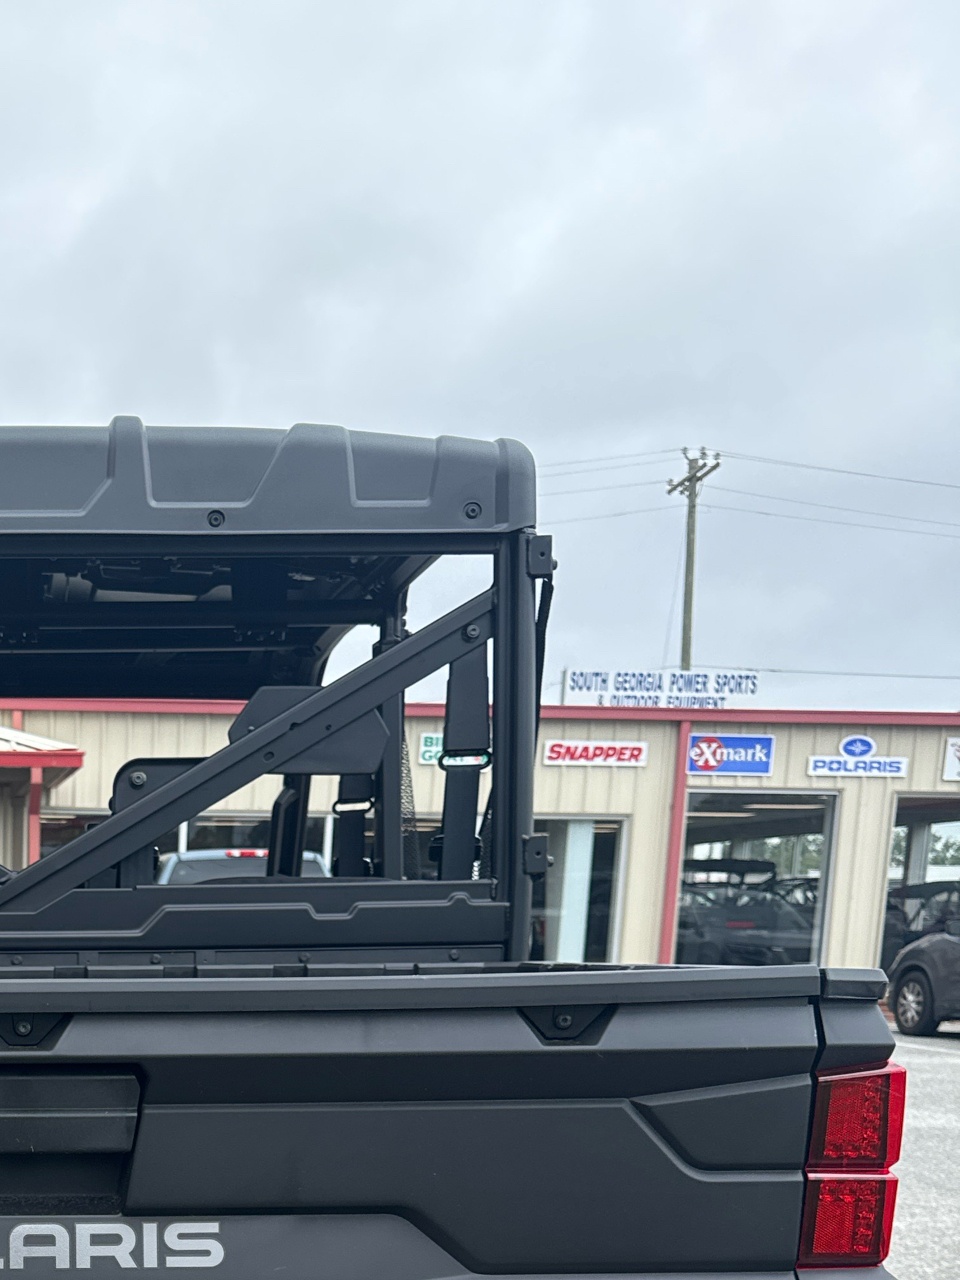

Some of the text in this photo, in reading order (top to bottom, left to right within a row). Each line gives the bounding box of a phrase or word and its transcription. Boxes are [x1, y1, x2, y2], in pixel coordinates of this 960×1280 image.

[569, 671, 758, 695] SOUTH GEORGIA POWER SPORTS
[610, 694, 661, 707] OUTDOOR
[666, 695, 727, 708] EQUIPMENT
[547, 744, 643, 762] SNAPPER
[812, 759, 902, 773] POLARIS
